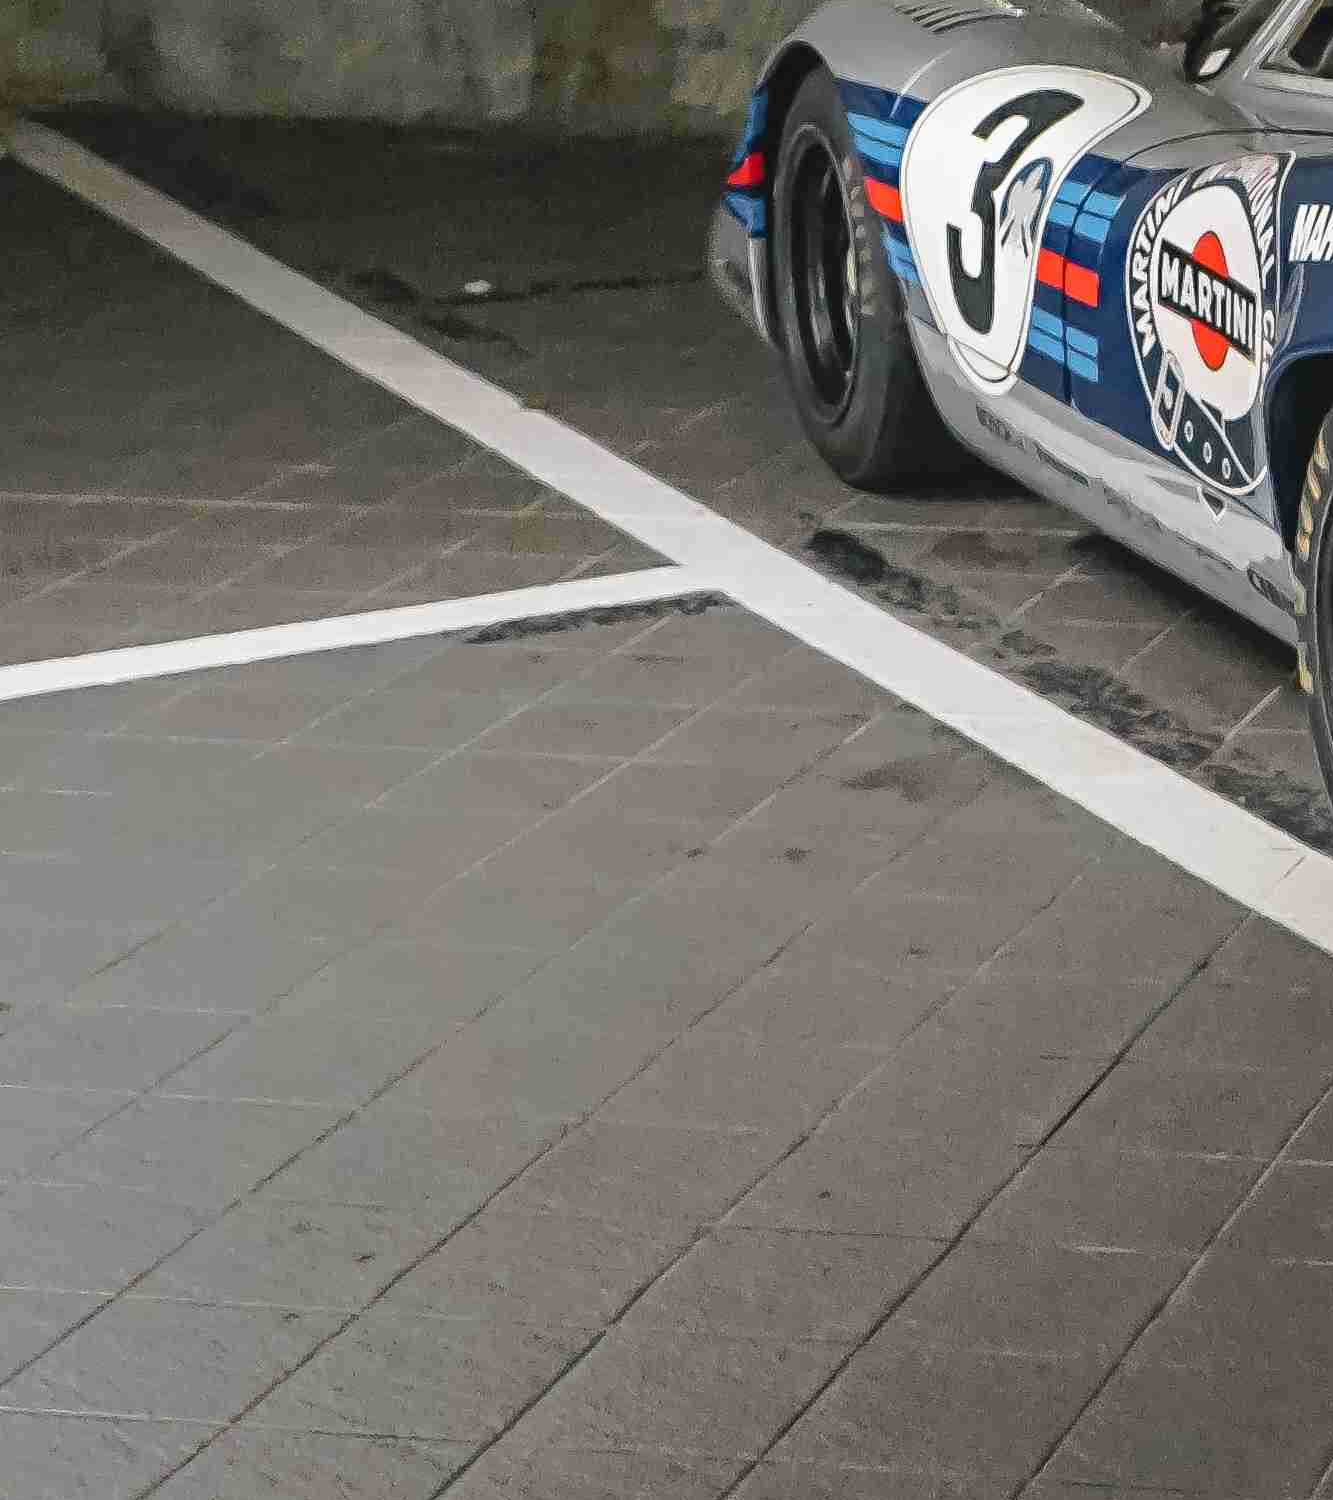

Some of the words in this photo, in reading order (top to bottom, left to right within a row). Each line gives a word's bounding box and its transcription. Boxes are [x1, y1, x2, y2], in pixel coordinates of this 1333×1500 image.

[946, 89, 1085, 335] 3
[1132, 176, 1188, 358] MARTINI
[1160, 252, 1255, 350] MARTINI
